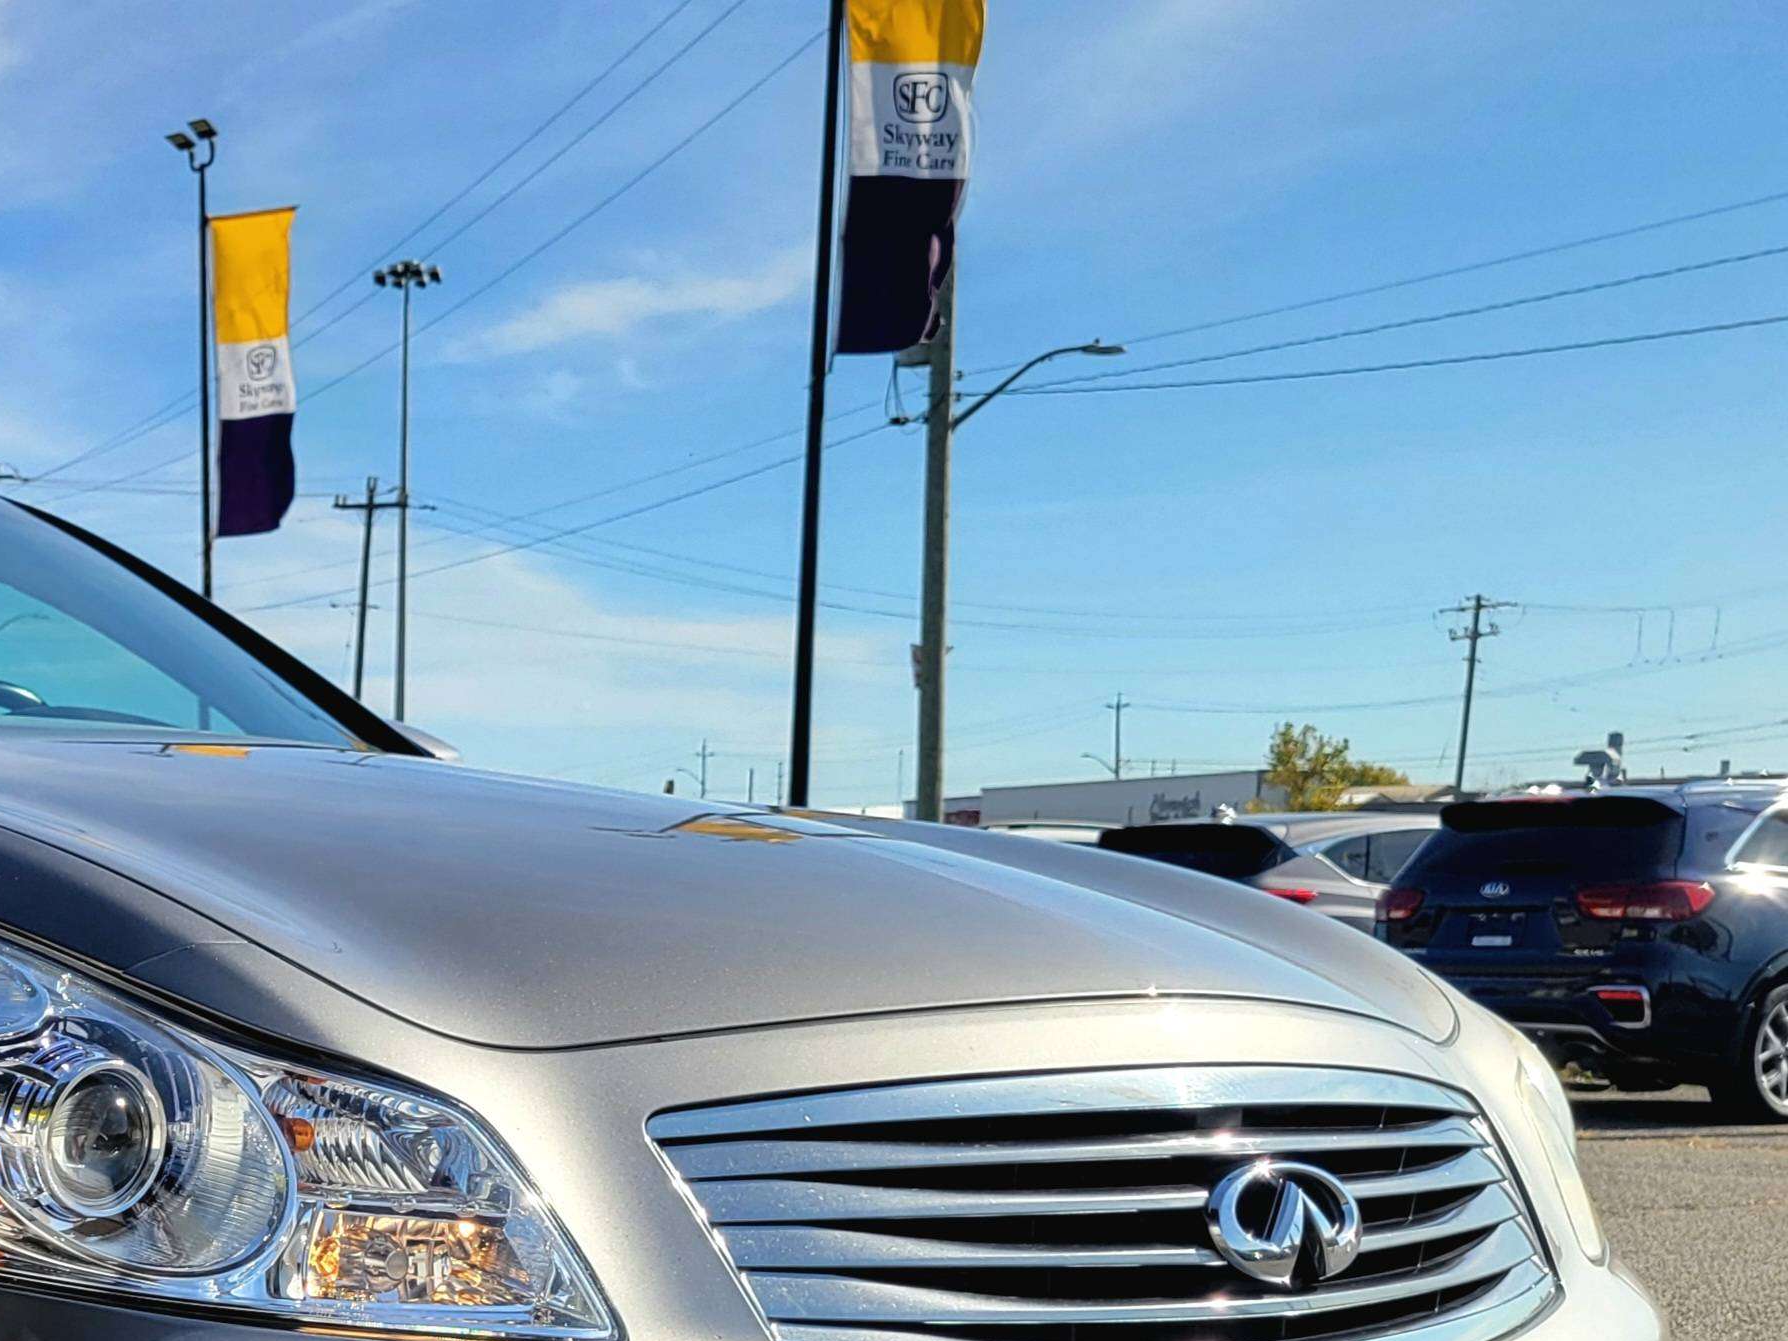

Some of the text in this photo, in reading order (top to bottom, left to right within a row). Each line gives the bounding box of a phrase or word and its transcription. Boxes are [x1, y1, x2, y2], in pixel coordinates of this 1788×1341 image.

[899, 81, 943, 114] SFC
[883, 123, 958, 152] Skyway
[883, 150, 955, 170] Fine Cars
